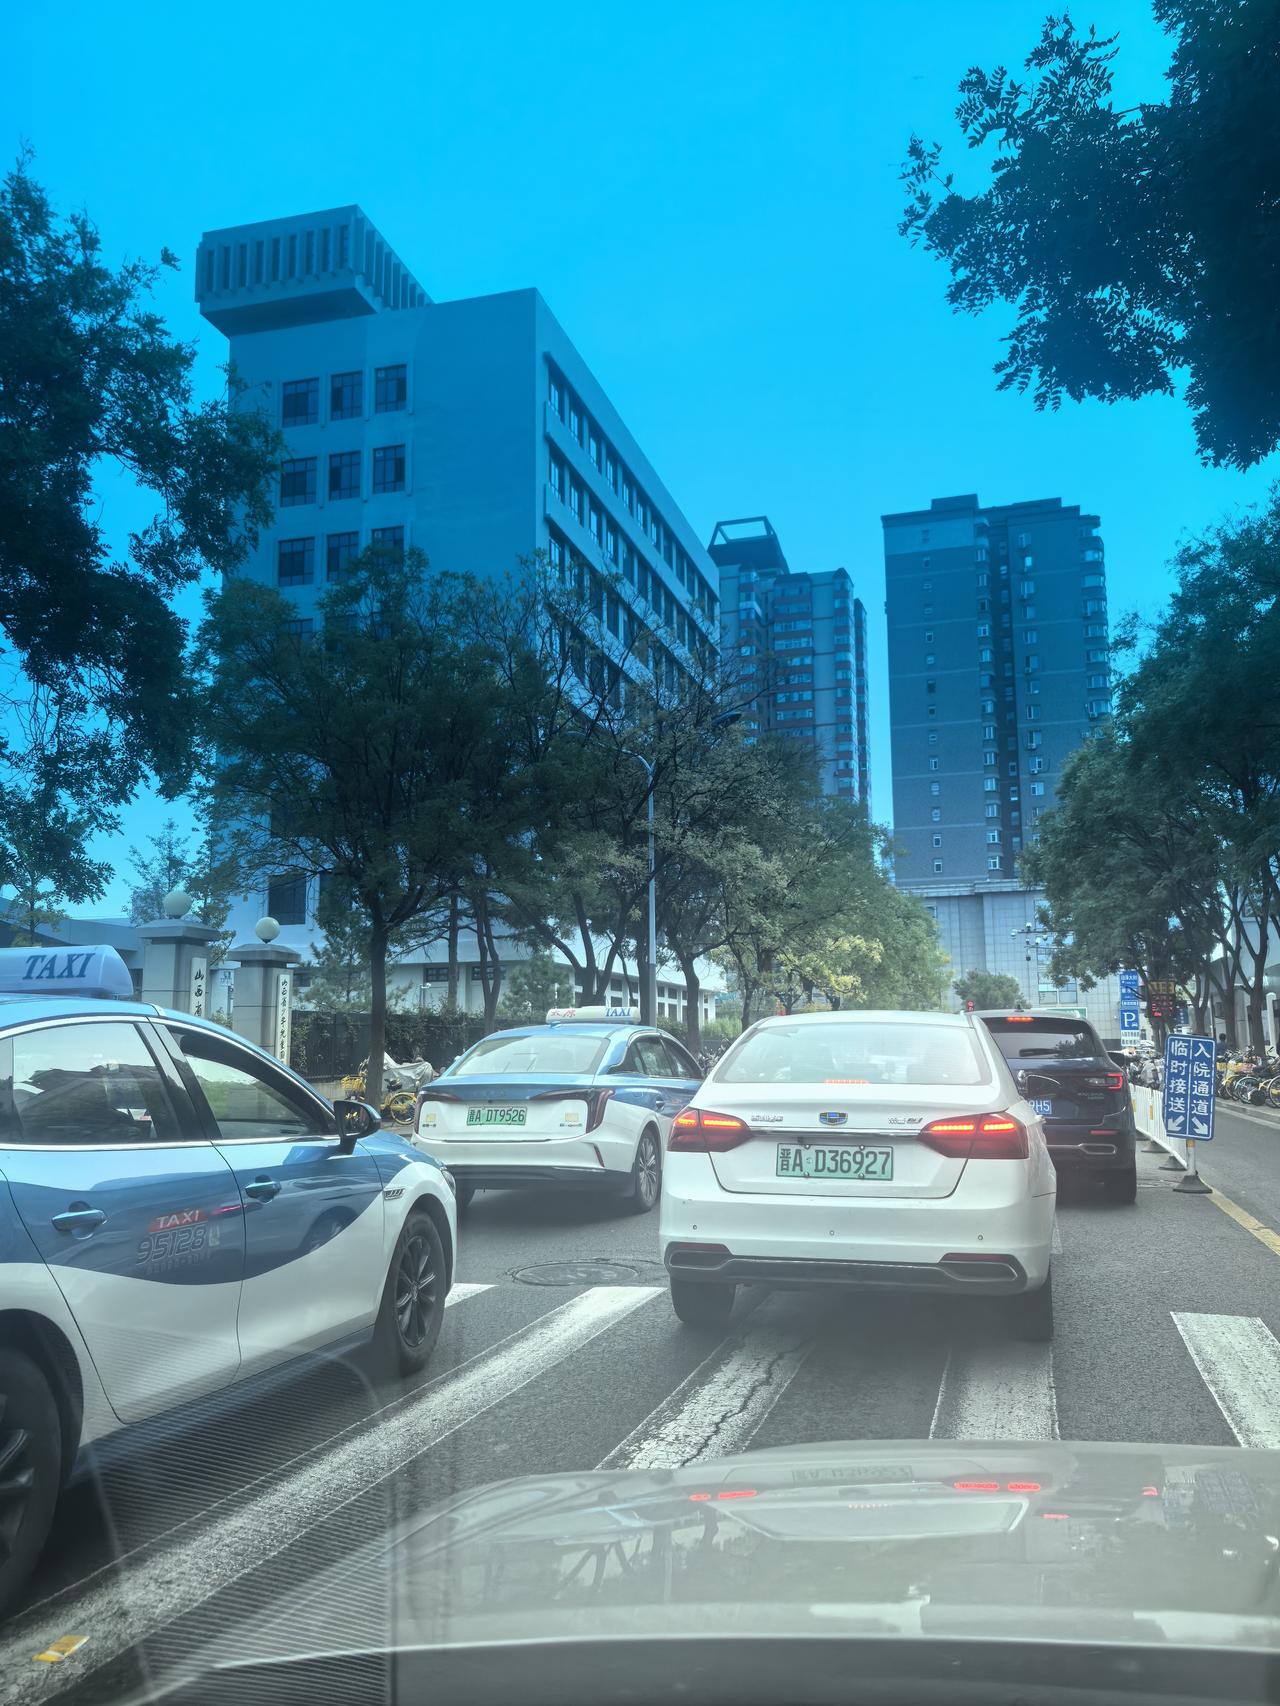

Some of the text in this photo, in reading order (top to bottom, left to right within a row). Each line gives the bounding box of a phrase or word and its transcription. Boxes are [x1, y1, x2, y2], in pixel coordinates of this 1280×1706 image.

[22, 953, 96, 980] TAXI
[605, 1008, 631, 1017] TAXI
[1124, 1012, 1136, 1027] P
[1168, 1040, 1188, 1113] 临时接送
[1191, 1042, 1212, 1116] 入院通道
[157, 1209, 200, 1229] TAXI
[136, 1224, 207, 1266] 95128
